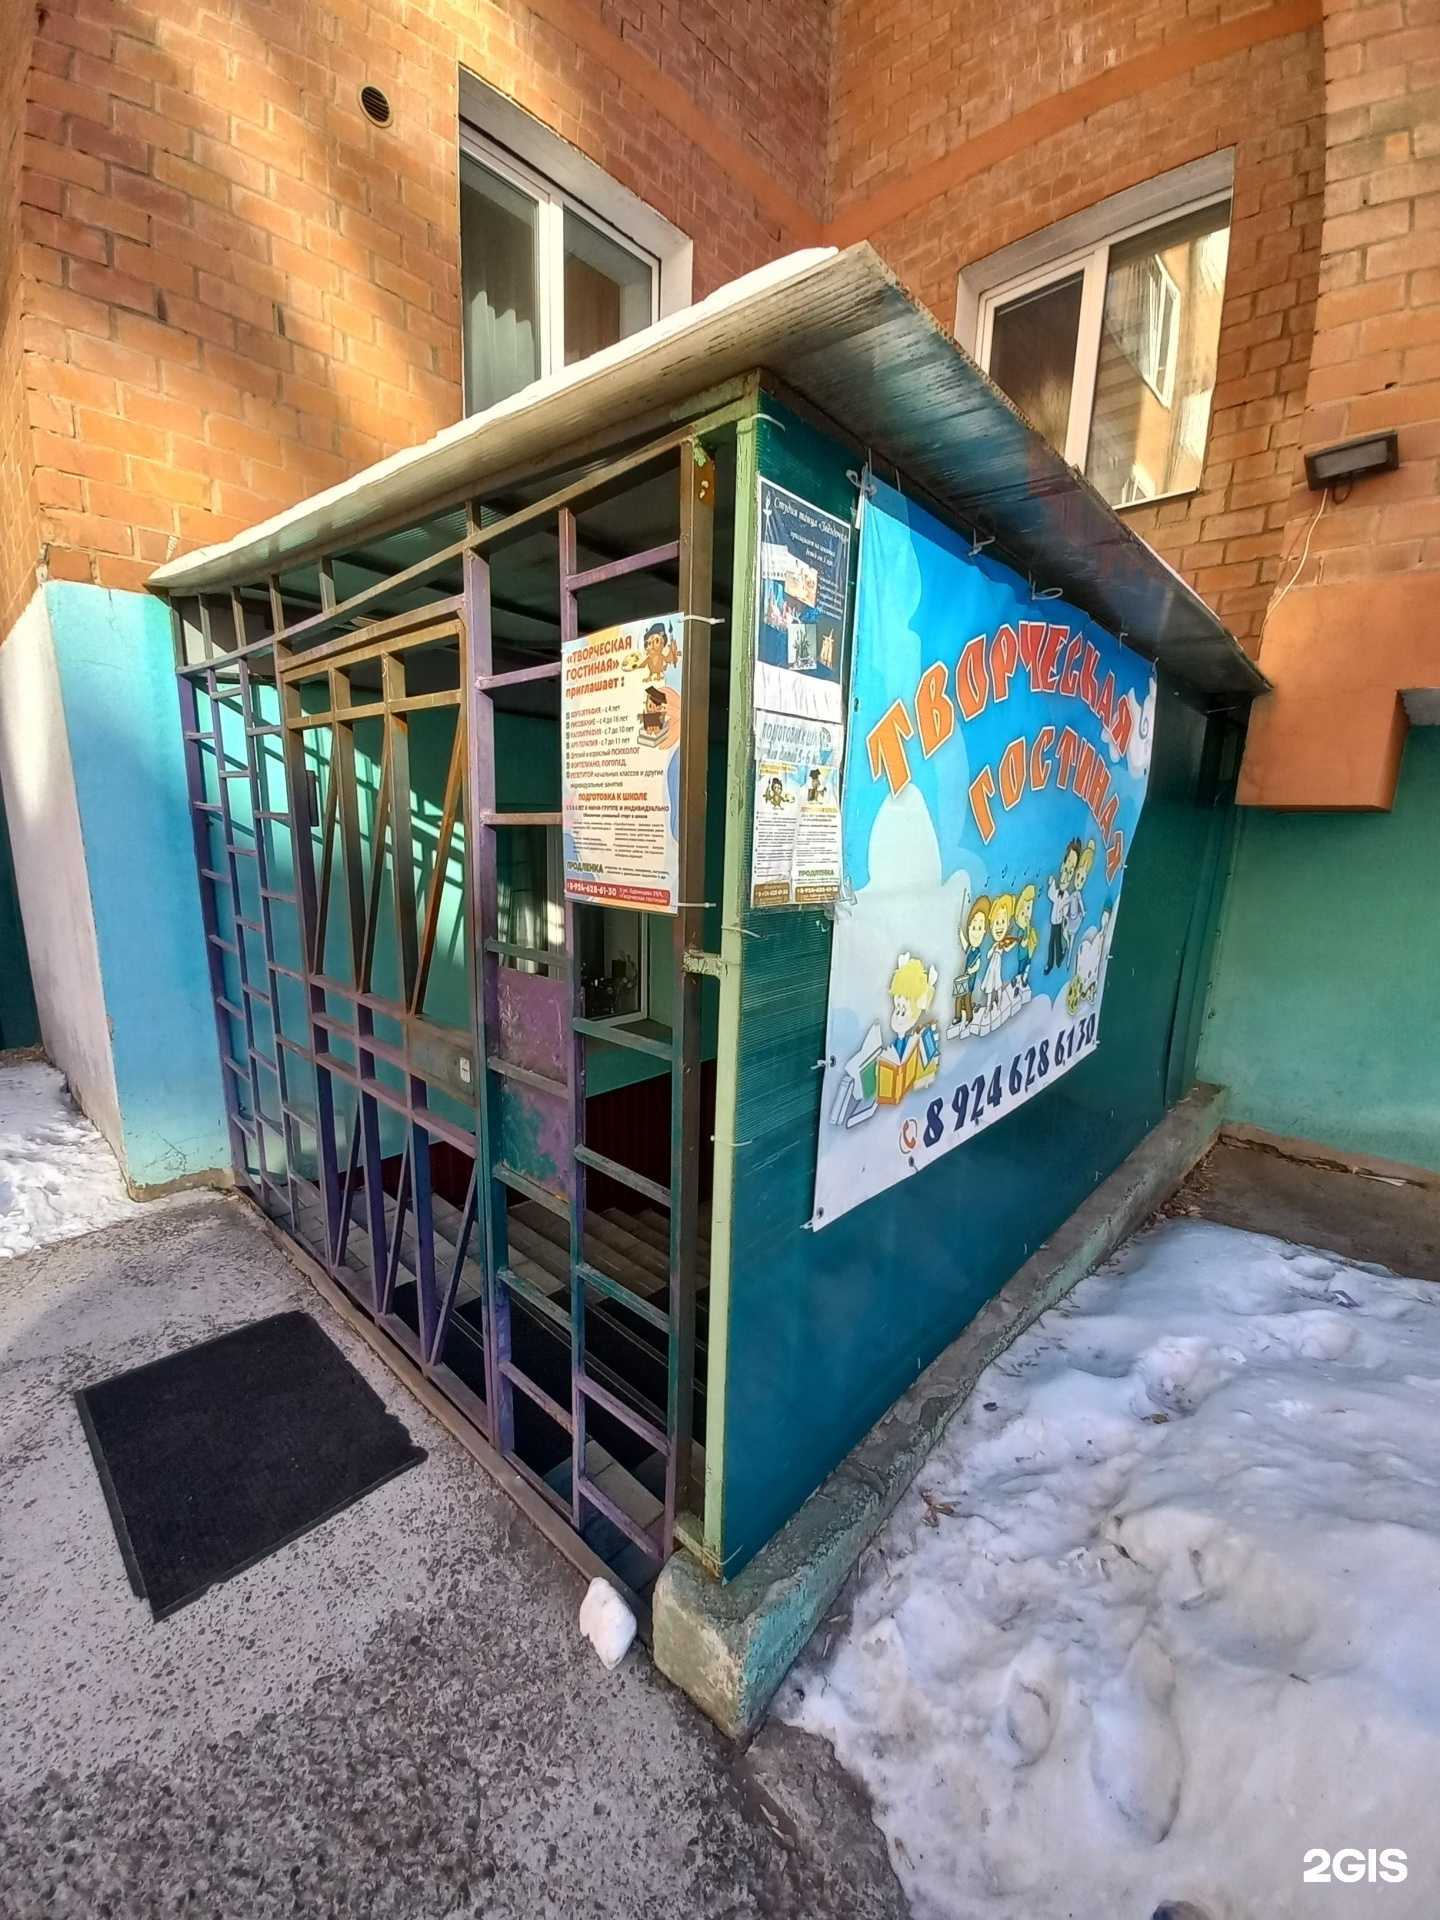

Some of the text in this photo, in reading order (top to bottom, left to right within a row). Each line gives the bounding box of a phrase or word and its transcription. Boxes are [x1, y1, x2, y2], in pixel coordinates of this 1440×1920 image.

[566, 658, 620, 681] ГОСТИНАЯ»
[567, 635, 632, 664] «ТВОРЧЕСКАЯ
[866, 620, 1133, 800] ТВОРЧЕСКАЯ
[578, 793, 616, 802] ПОДГОТОВКА
[622, 792, 648, 801] ШКОЛЕ
[969, 725, 1124, 885] ГОСТИНАЯ
[923, 1097, 944, 1148] 8
[951, 1064, 1003, 1131] 924
[1008, 1039, 1050, 1096] 628
